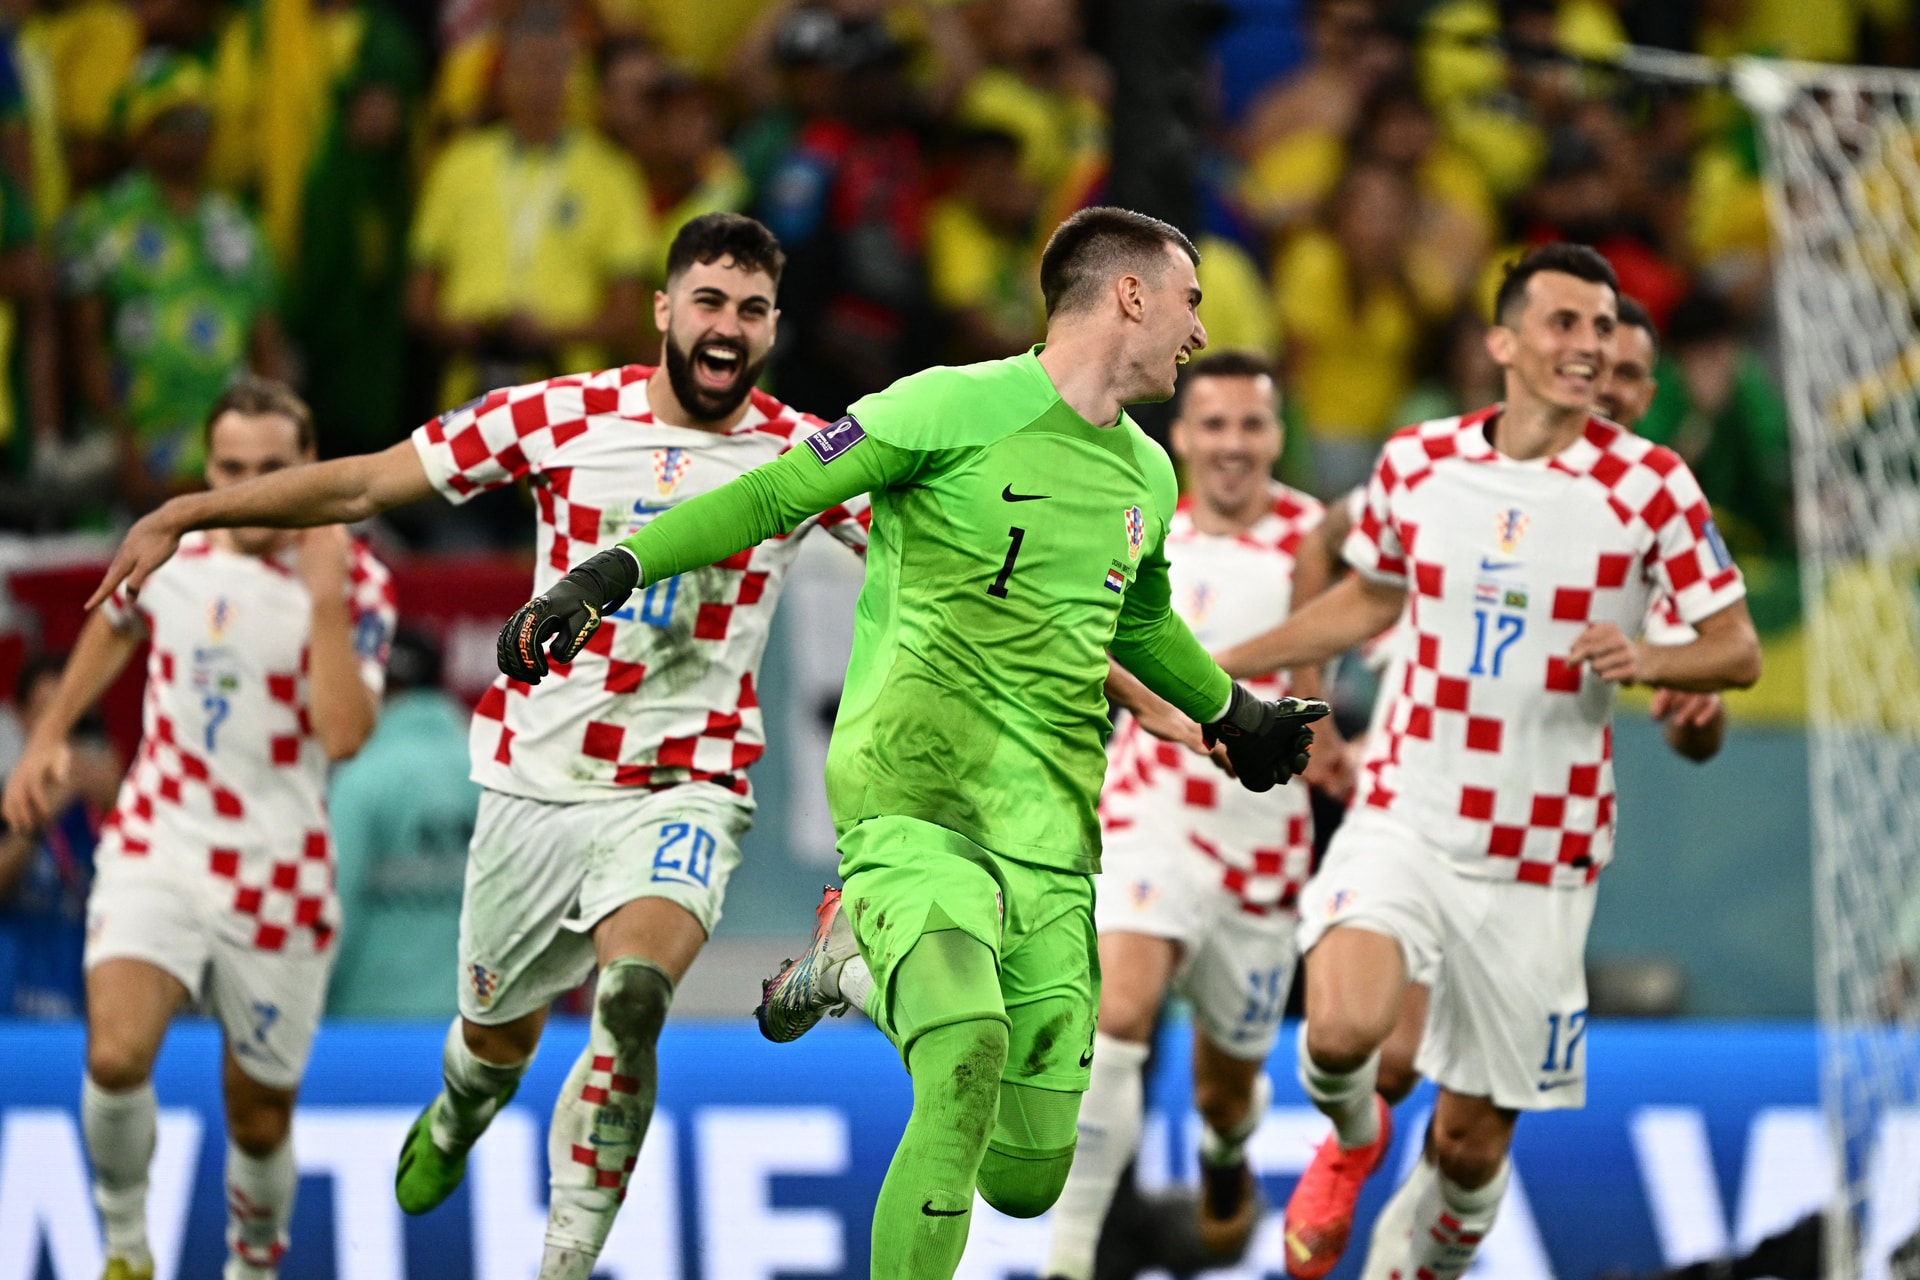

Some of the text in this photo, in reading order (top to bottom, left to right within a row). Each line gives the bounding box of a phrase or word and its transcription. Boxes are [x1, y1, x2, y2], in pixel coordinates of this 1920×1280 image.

[986, 526, 1025, 600] 1
[603, 575, 682, 628] 0
[1468, 610, 1526, 678] 17
[202, 695, 230, 753] 7
[653, 822, 717, 889] 20
[251, 1000, 281, 1043] 7
[1541, 1007, 1588, 1071] 17
